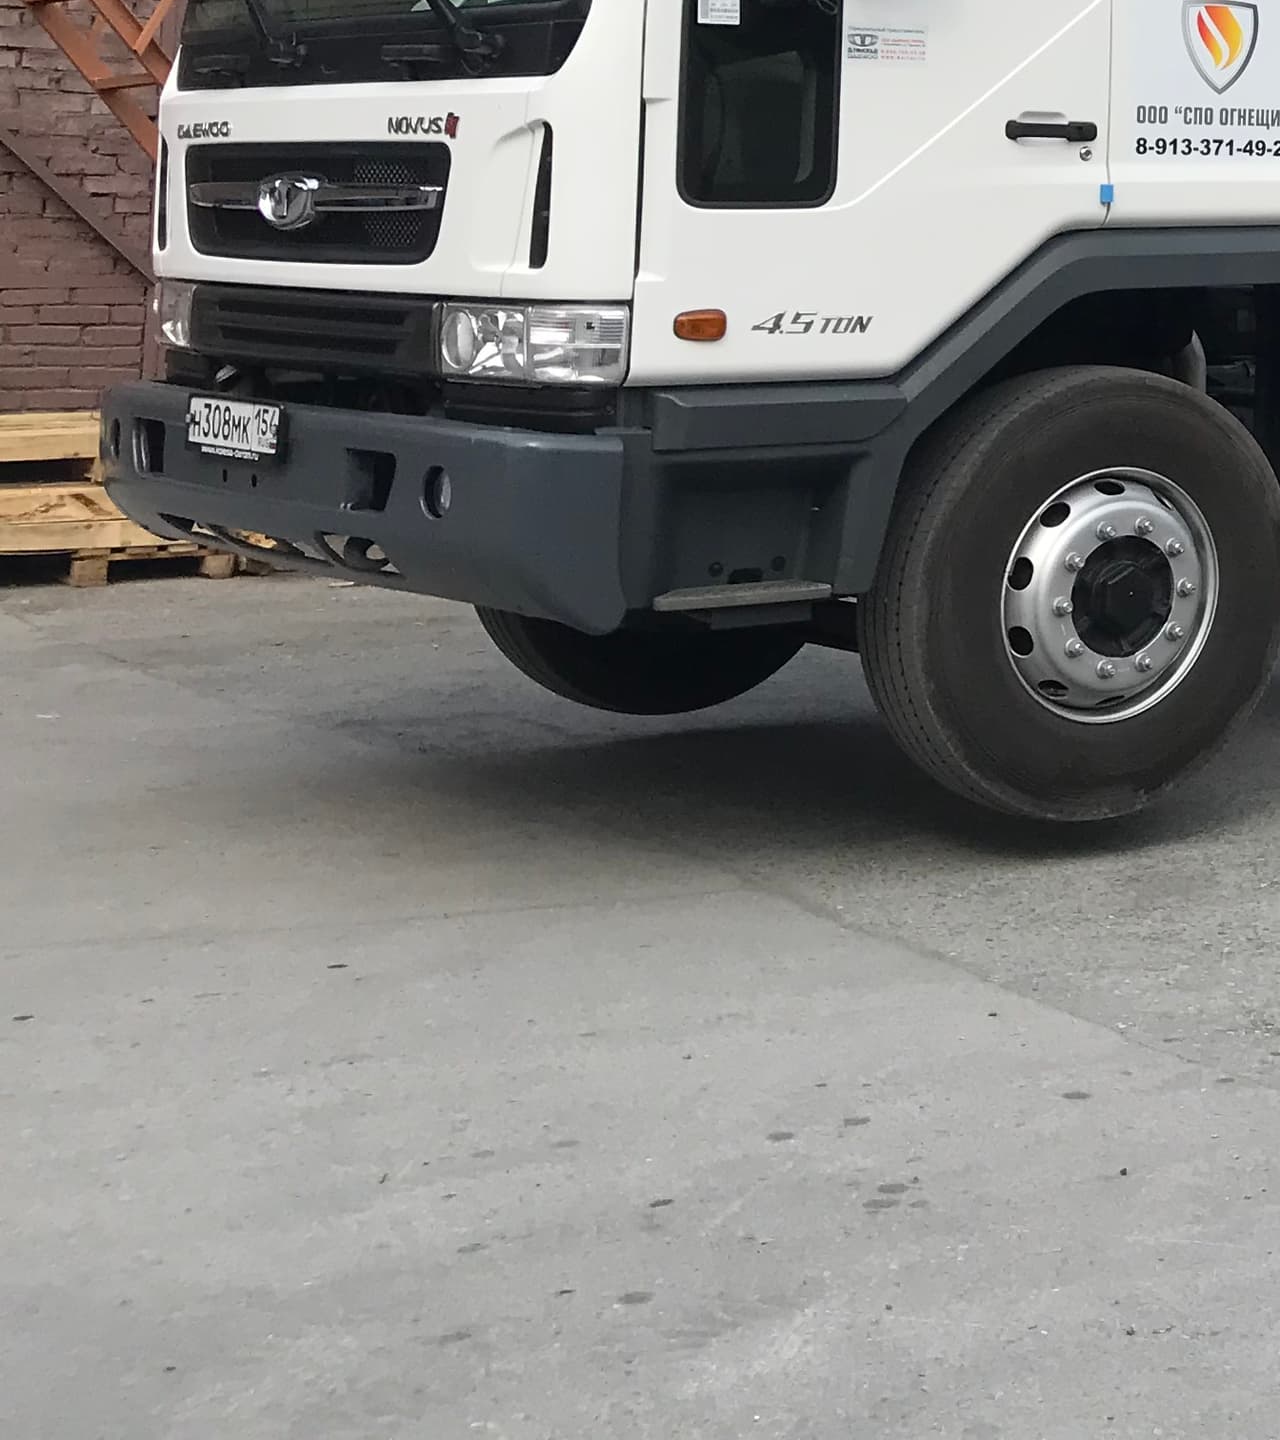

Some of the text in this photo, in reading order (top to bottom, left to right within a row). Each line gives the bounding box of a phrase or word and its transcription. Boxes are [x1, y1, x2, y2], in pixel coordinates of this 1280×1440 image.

[1136, 105, 1169, 124] ООО
[387, 117, 444, 135] NOVUS
[751, 311, 873, 334] 4.5 TON
